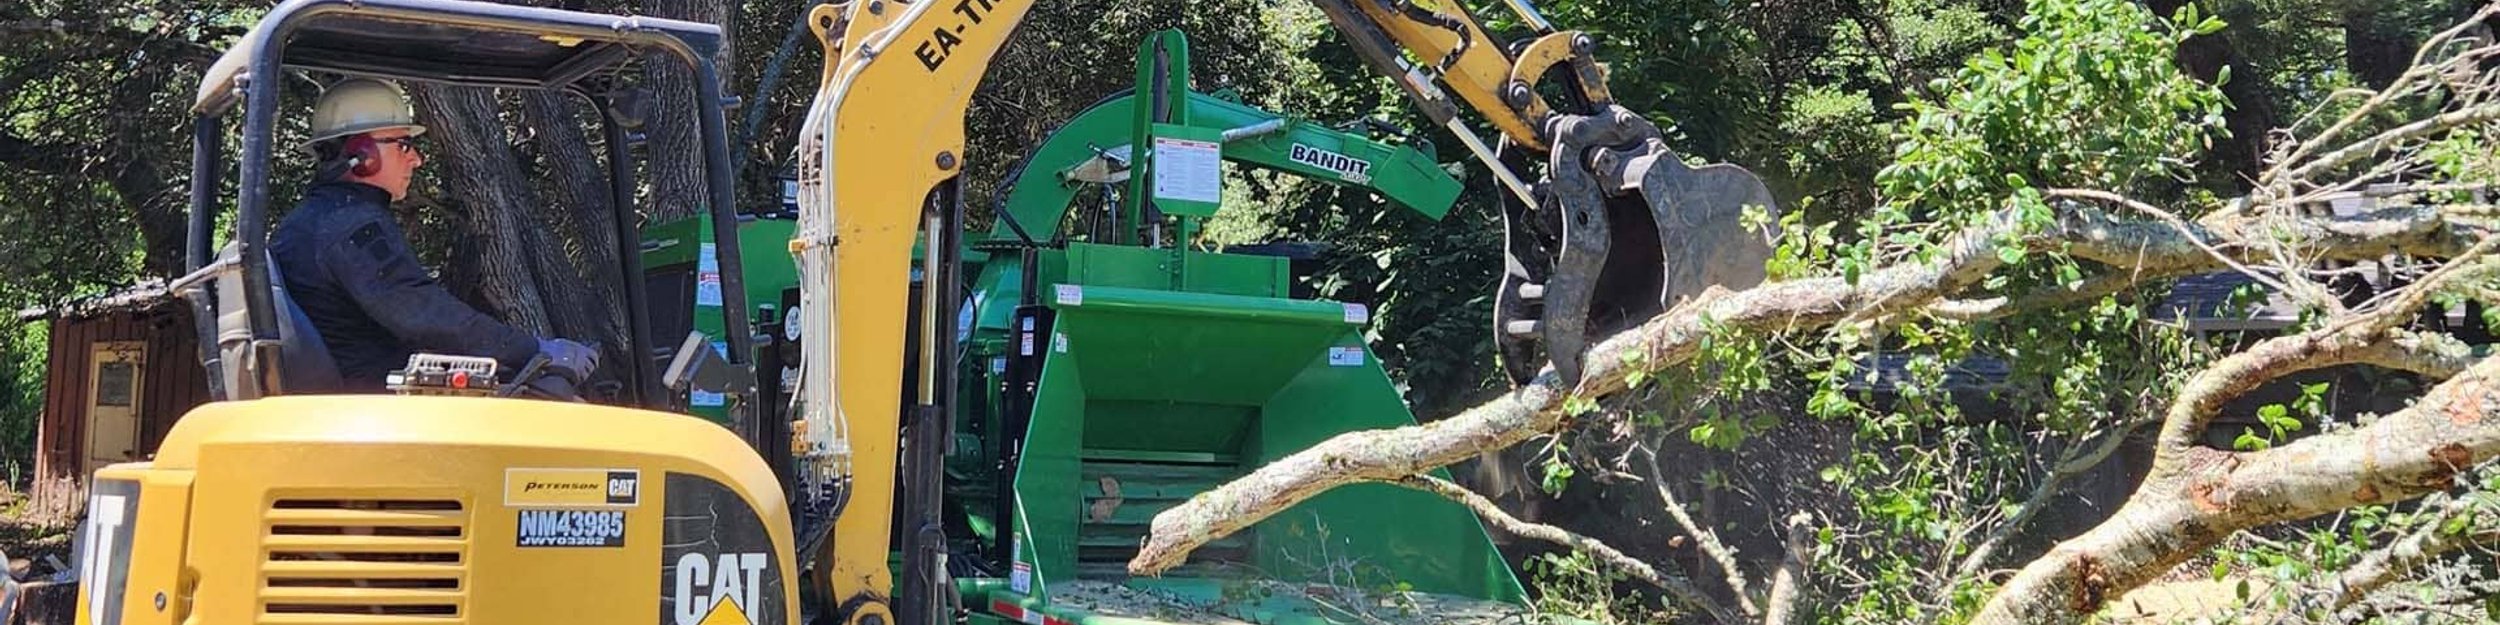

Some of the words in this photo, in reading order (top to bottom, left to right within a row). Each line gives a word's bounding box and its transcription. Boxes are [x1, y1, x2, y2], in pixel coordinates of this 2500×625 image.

[1290, 143, 1371, 174] BANDIT
[524, 482, 599, 492] PETERSON
[609, 478, 635, 497] CAT
[520, 511, 623, 537] NM43985
[675, 552, 767, 625] CAT
